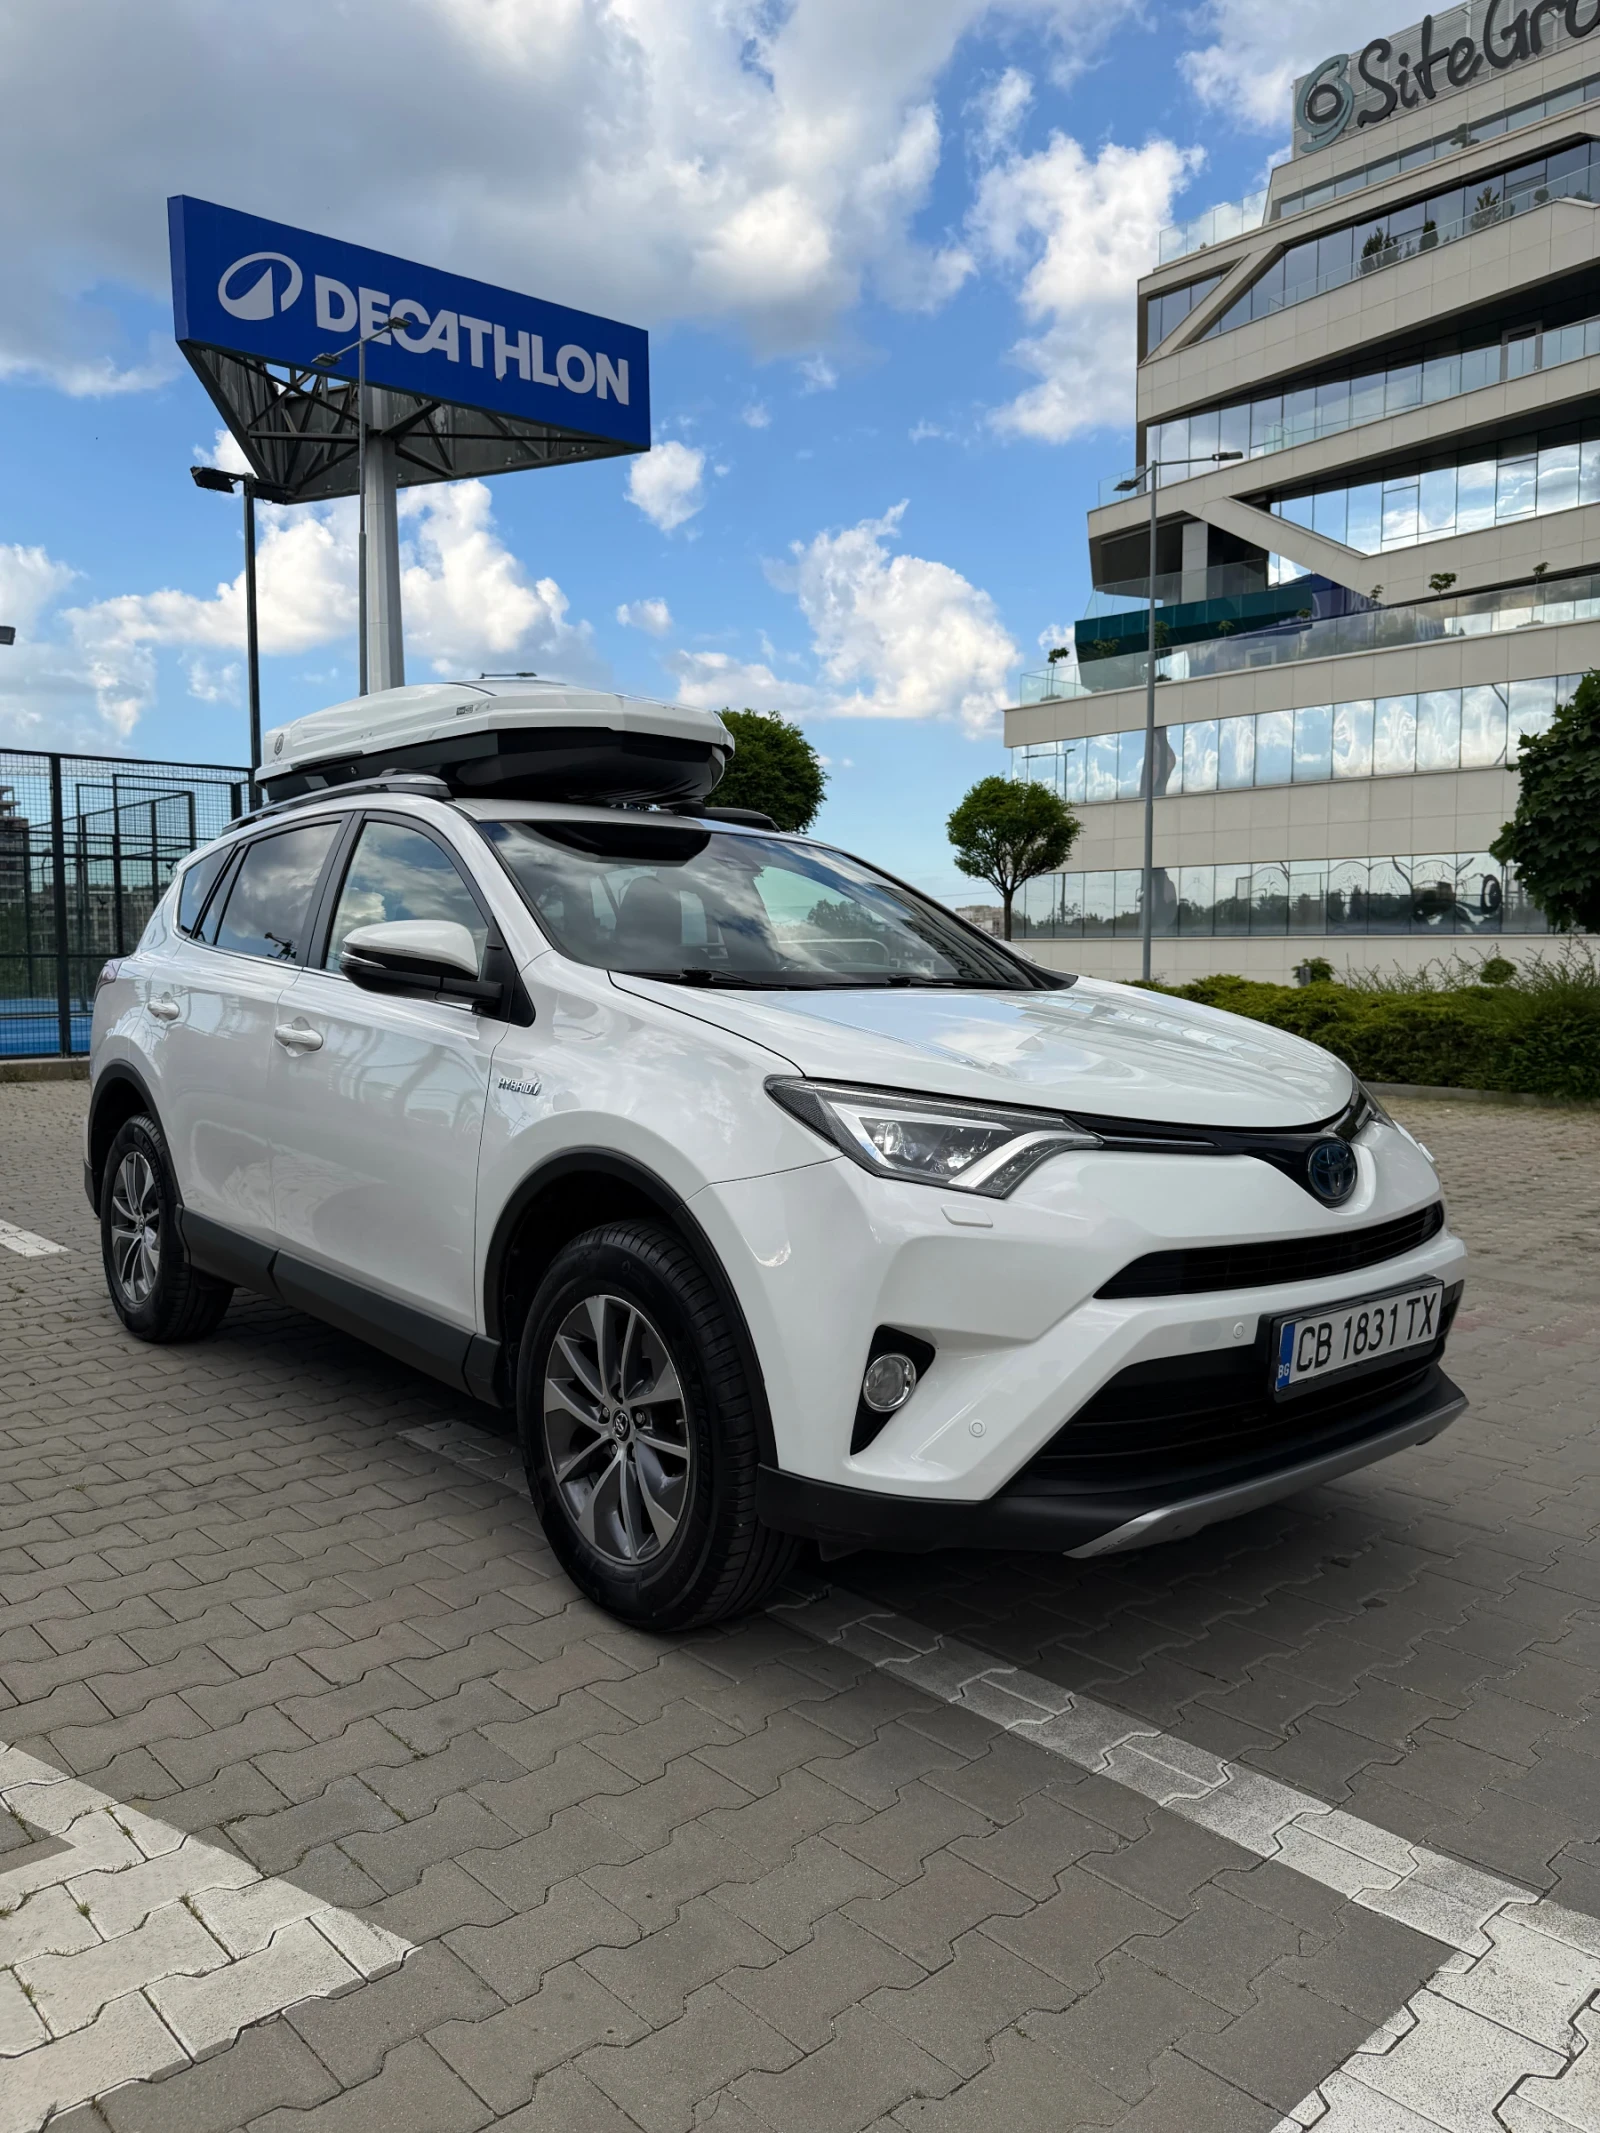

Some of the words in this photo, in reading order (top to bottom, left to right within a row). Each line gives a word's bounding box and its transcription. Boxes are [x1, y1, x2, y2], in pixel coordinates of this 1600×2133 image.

[314, 274, 630, 406] DECATHLON
[498, 1078, 533, 1094] HYBRID
[1296, 1322, 1333, 1372] CB
[1342, 1303, 1399, 1360] 1831
[1406, 1293, 1437, 1341] TX
[1278, 1363, 1290, 1378] BG
